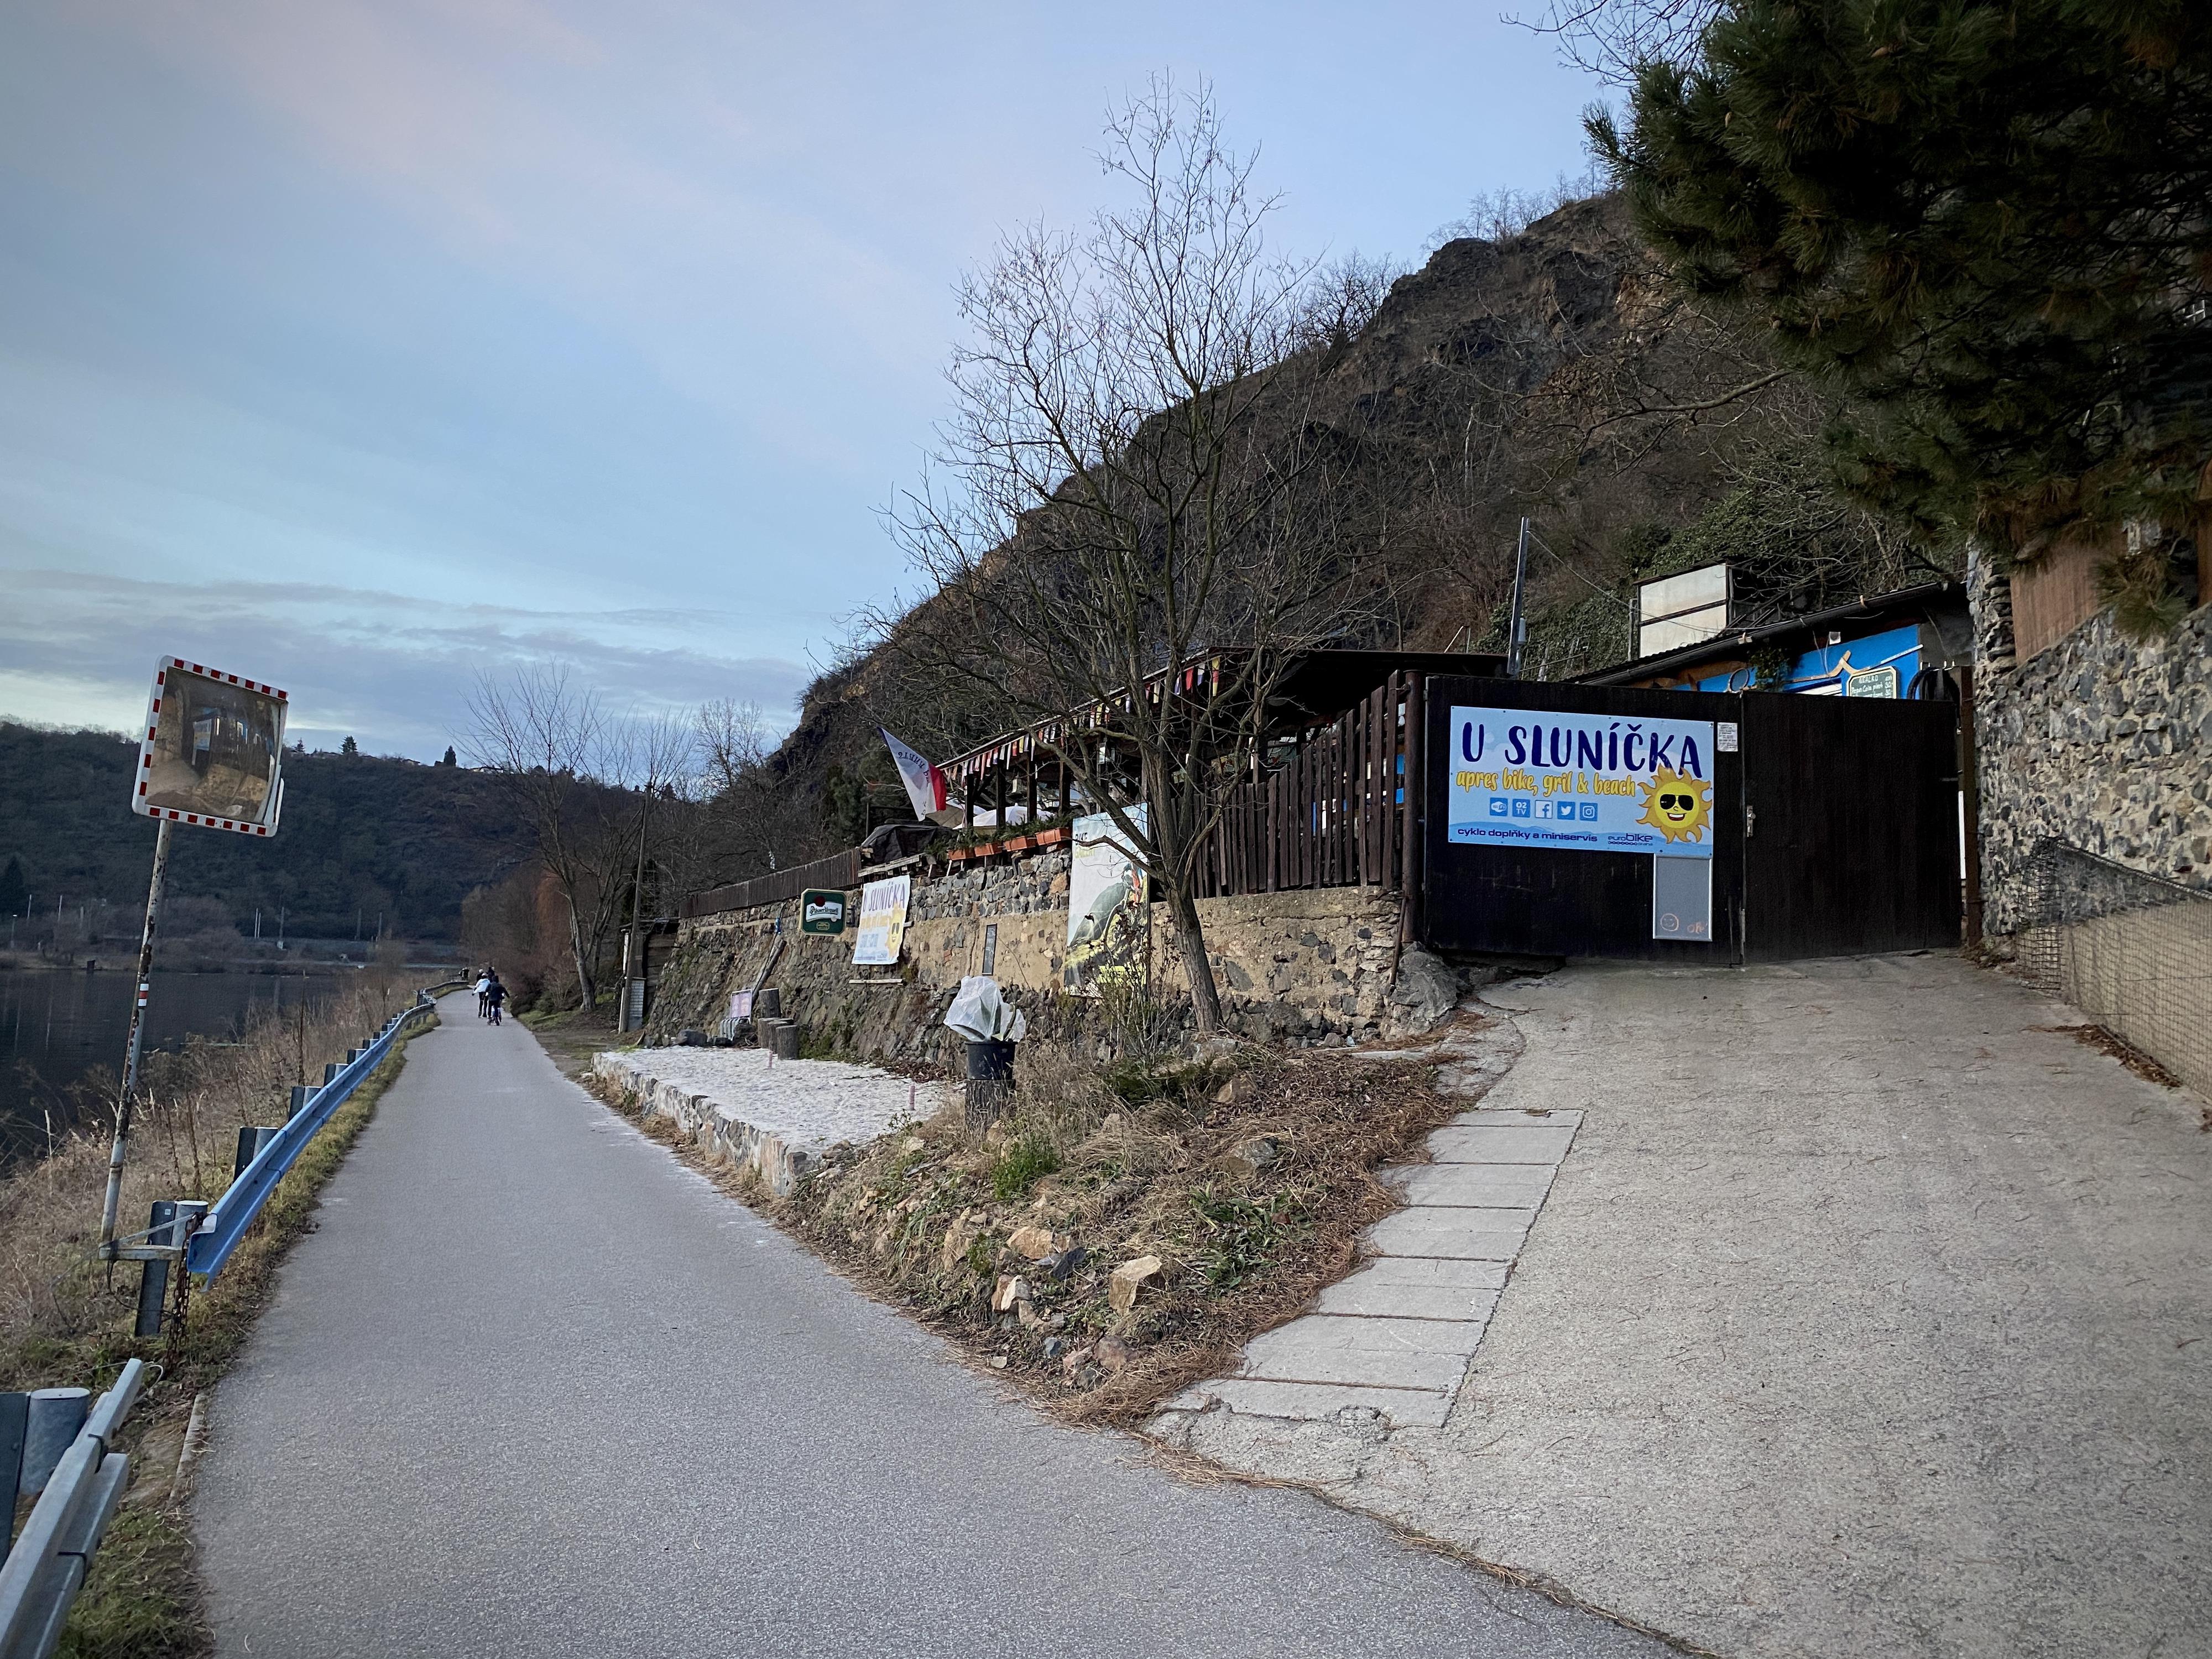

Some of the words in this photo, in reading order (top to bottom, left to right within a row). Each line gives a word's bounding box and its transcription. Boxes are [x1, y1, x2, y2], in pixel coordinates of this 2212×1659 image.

[1462, 722, 1484, 762] U
[1505, 722, 1702, 779] SLUNÍČKA
[1457, 771, 1498, 792] apres
[1503, 767, 1538, 796] bike,
[1543, 771, 1573, 797] gril
[1577, 772, 1588, 794] &
[1593, 772, 1635, 797] beach
[1458, 828, 1485, 837] cyklo
[1489, 829, 1531, 840] doplňky
[1542, 832, 1597, 842] miniservis
[1608, 833, 1653, 842] eurobike
[863, 891, 867, 912] U
[869, 881, 905, 911] SLUNÍČKA
